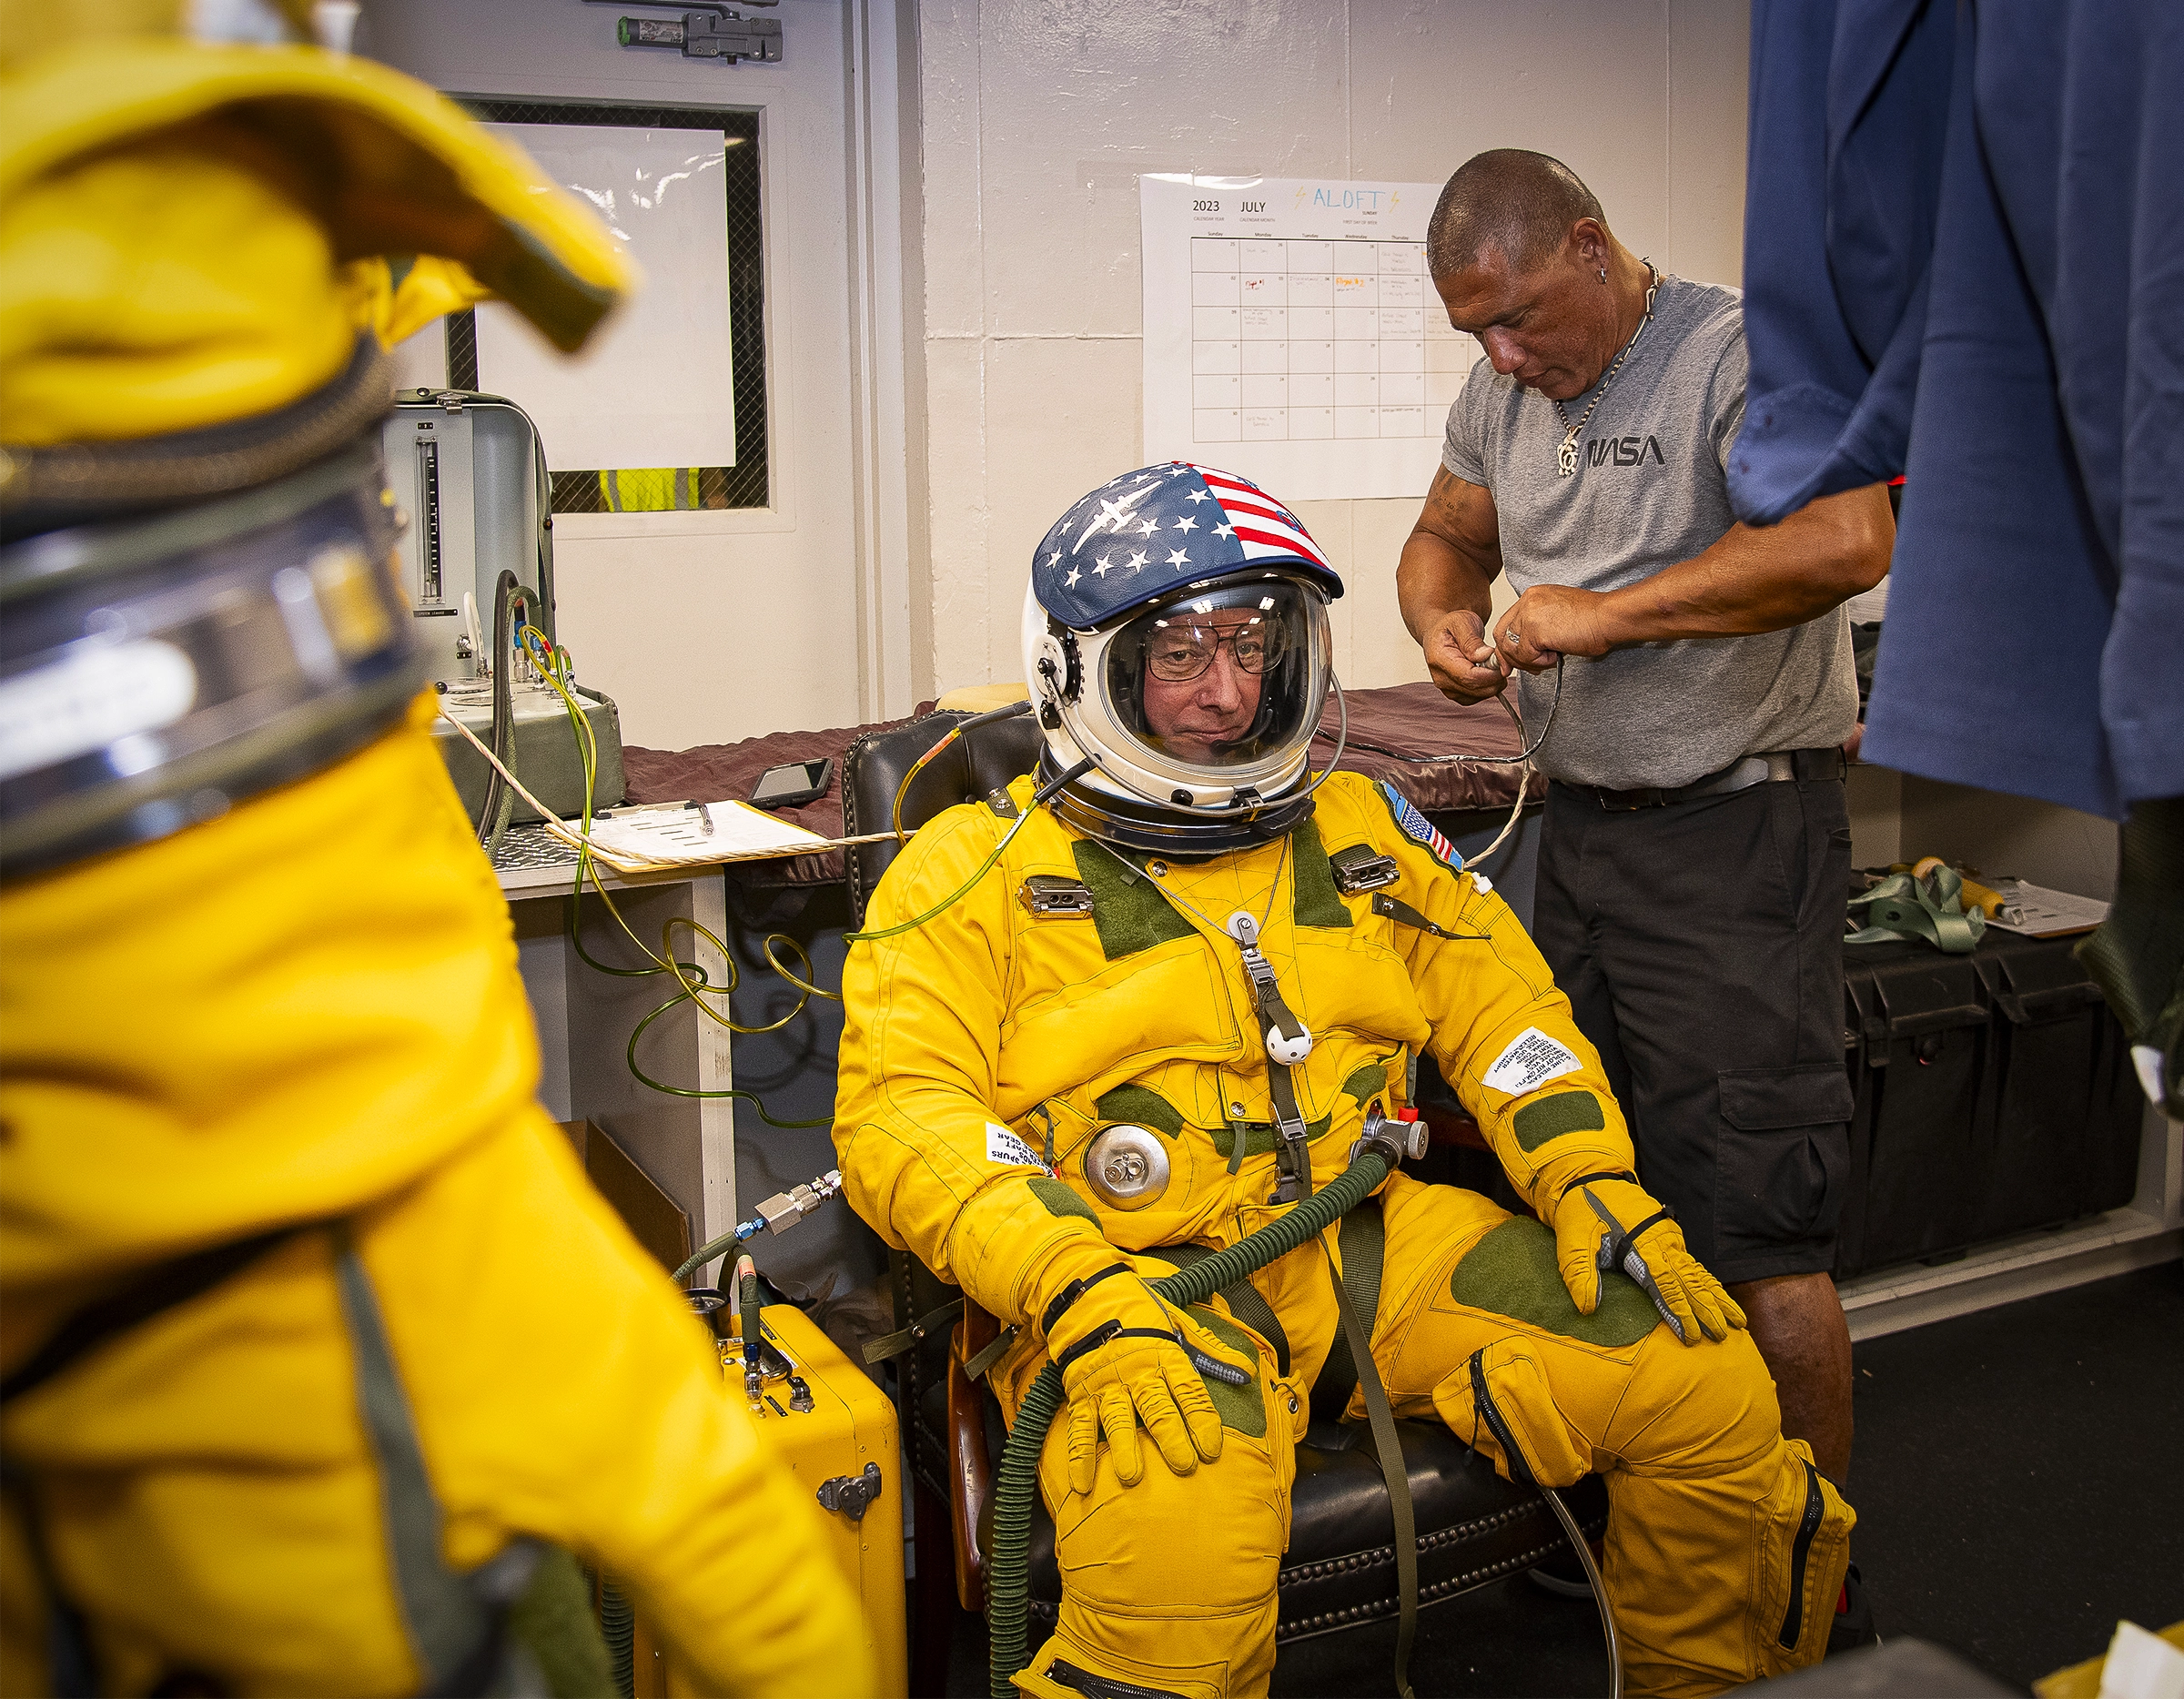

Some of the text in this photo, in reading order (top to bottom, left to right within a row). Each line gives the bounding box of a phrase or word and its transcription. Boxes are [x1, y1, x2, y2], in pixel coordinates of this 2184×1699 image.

[1313, 188, 1385, 208] ALOFT
[1193, 200, 1266, 212] 2023 JULY
[1587, 435, 1665, 468] NASA
[1538, 1043, 1553, 1053] VENT
[1502, 1051, 1518, 1068] WATER
[1545, 1052, 1566, 1065] DEPLOY
[1526, 1061, 1540, 1073] VEST
[1535, 1063, 1545, 1072] KIT
[1527, 1067, 1550, 1085] RELEASE
[998, 1133, 1020, 1145] GEAR
[992, 1151, 1019, 1164] SPURS
